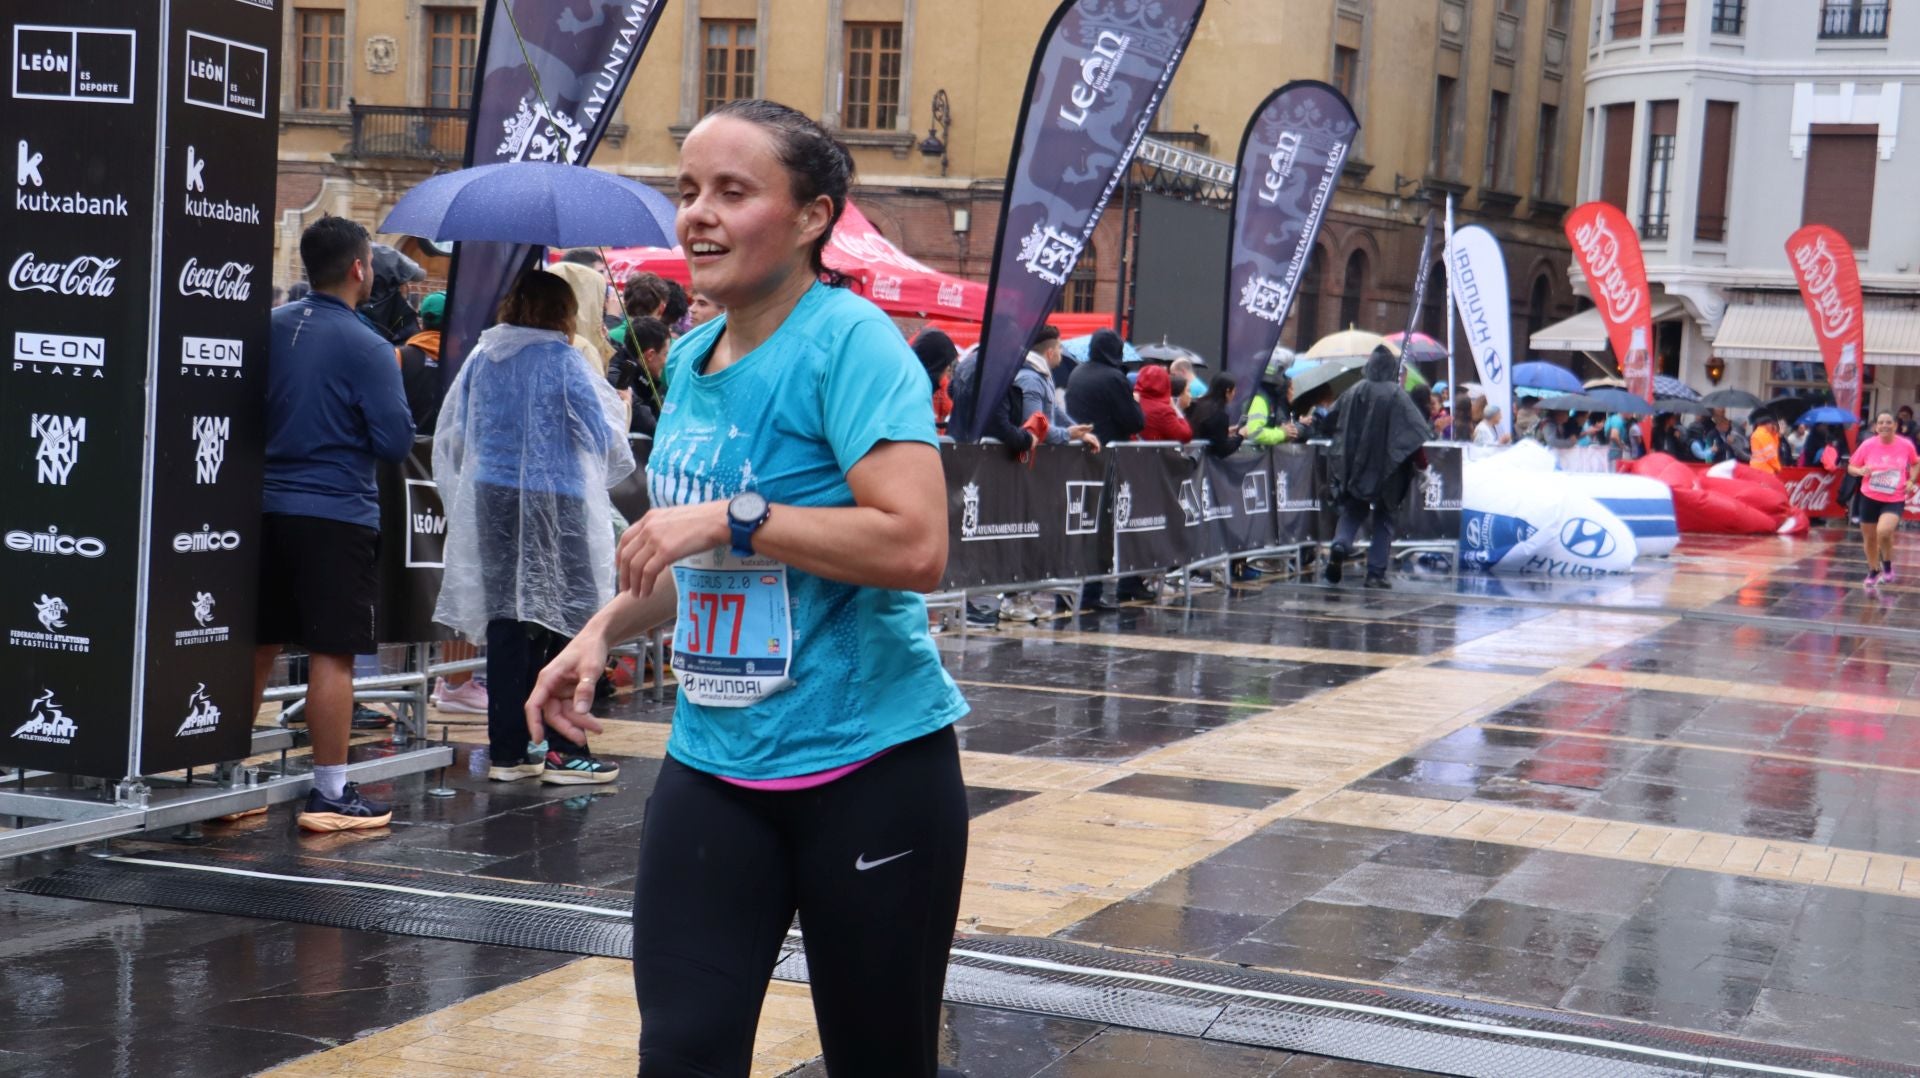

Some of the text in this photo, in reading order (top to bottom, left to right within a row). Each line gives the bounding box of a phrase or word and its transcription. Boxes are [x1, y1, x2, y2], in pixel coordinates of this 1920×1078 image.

[21, 49, 68, 72] LEÓN
[191, 58, 223, 82] LEÓN
[80, 72, 90, 80] ES
[80, 83, 118, 93] DEPORTE
[230, 83, 238, 92] ES
[230, 94, 255, 107] DEPORTE
[16, 189, 128, 216] kutxabank
[185, 194, 260, 225] kutxabank
[1285, 194, 1323, 284] AYUNTAMIENTO
[1319, 175, 1329, 192] DE
[1325, 142, 1342, 173] LEÓN
[9, 252, 121, 297] Coca-Cola
[179, 257, 254, 301] Coca-Cola
[19, 337, 101, 360] LEON
[186, 342, 240, 361] LEON
[13, 363, 104, 378] PLAZA
[181, 367, 242, 378] PLAZA
[413, 508, 446, 534] LEÓN
[5, 525, 106, 558] emico
[173, 523, 241, 553] emico
[728, 576, 750, 589] 2.0
[688, 591, 746, 655] 577
[10, 630, 44, 640] FEDERACIÓN
[54, 635, 89, 644] ATLETISMO
[23, 639, 59, 649] CASTILLA
[70, 643, 89, 652] LEÓN
[184, 637, 208, 645] CASTILLA
[699, 679, 761, 694] HYUNDAI
[19, 734, 52, 742] ATLETISMO
